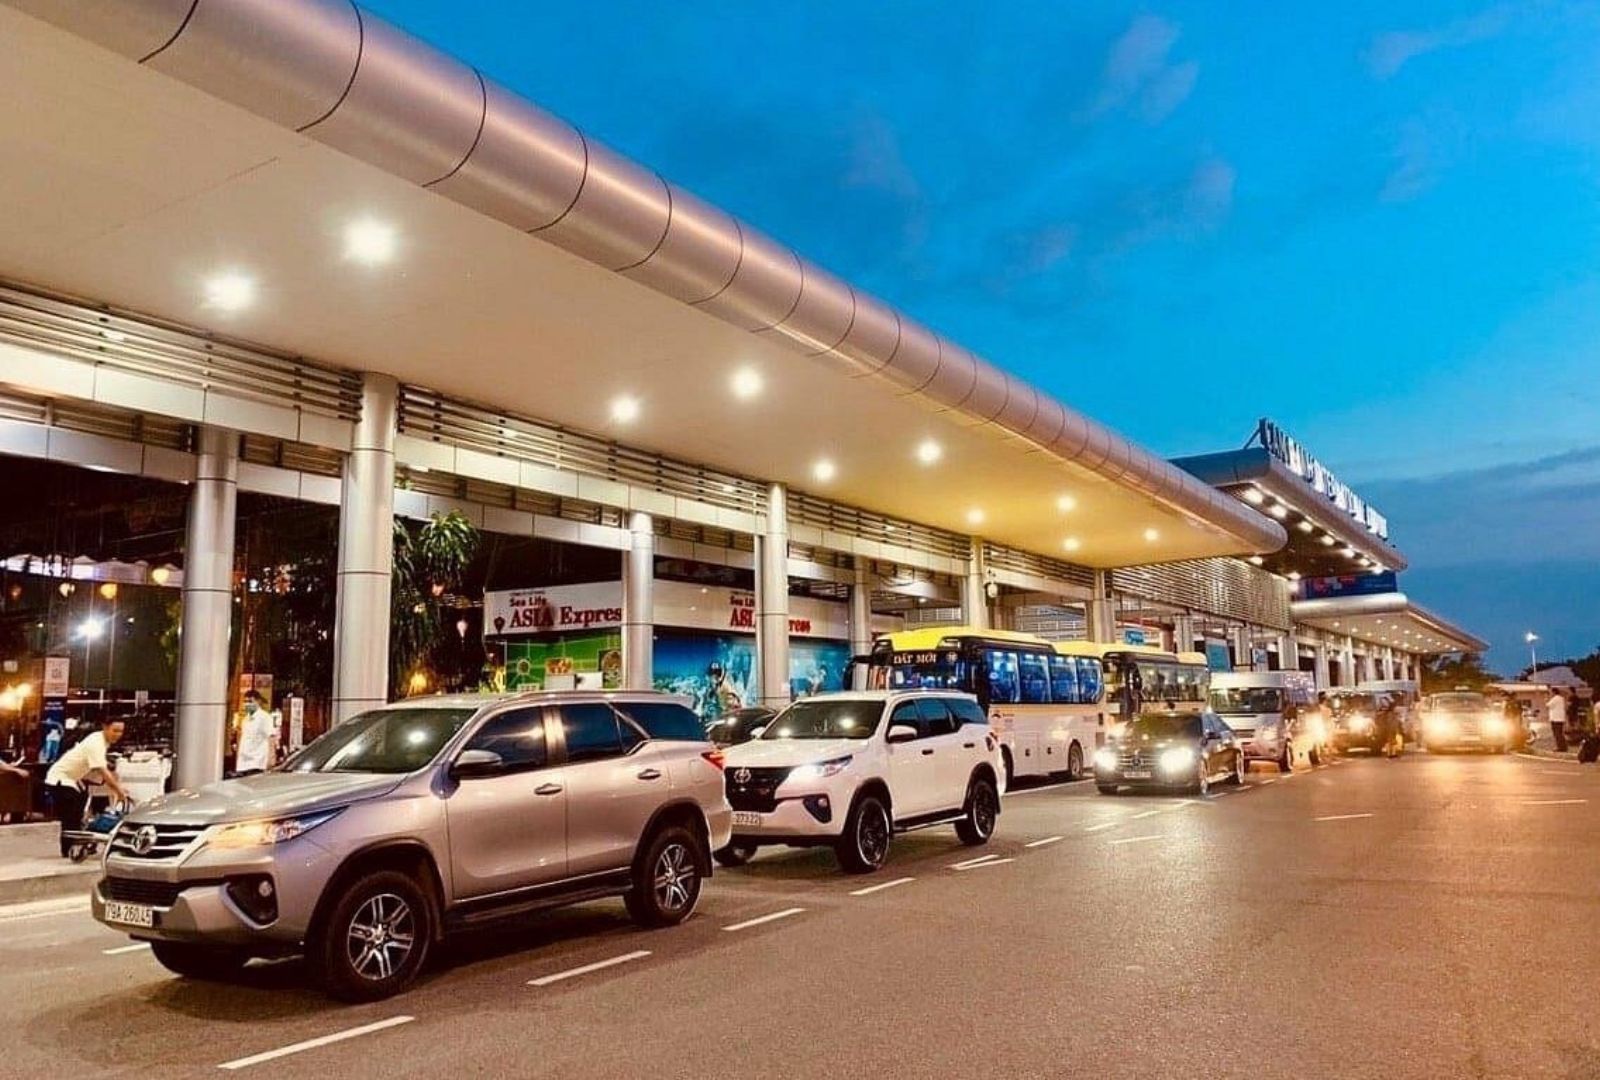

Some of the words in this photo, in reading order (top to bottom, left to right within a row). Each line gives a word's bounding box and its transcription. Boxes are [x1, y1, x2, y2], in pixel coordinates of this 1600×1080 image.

[509, 606, 554, 628] ASIA
[559, 606, 621, 627] Expres
[730, 608, 756, 628] ASI
